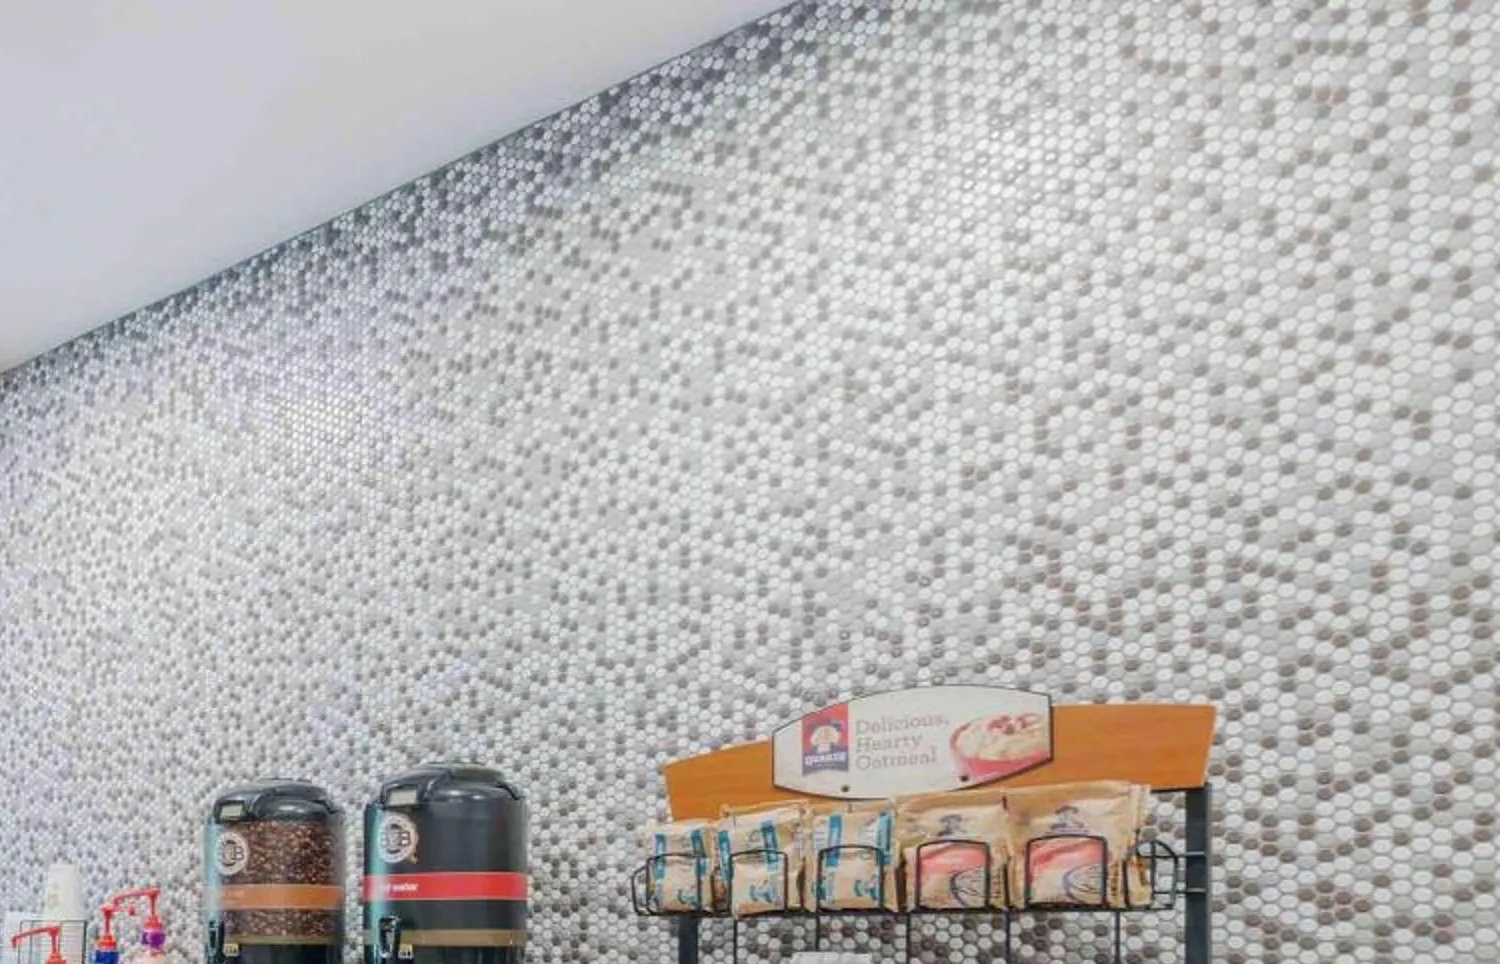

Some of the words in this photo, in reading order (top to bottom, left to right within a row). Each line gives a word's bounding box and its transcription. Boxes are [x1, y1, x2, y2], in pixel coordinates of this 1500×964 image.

[855, 713, 950, 735] Delicious,
[856, 732, 924, 754] Hearty
[855, 746, 938, 771] Oatmeal
